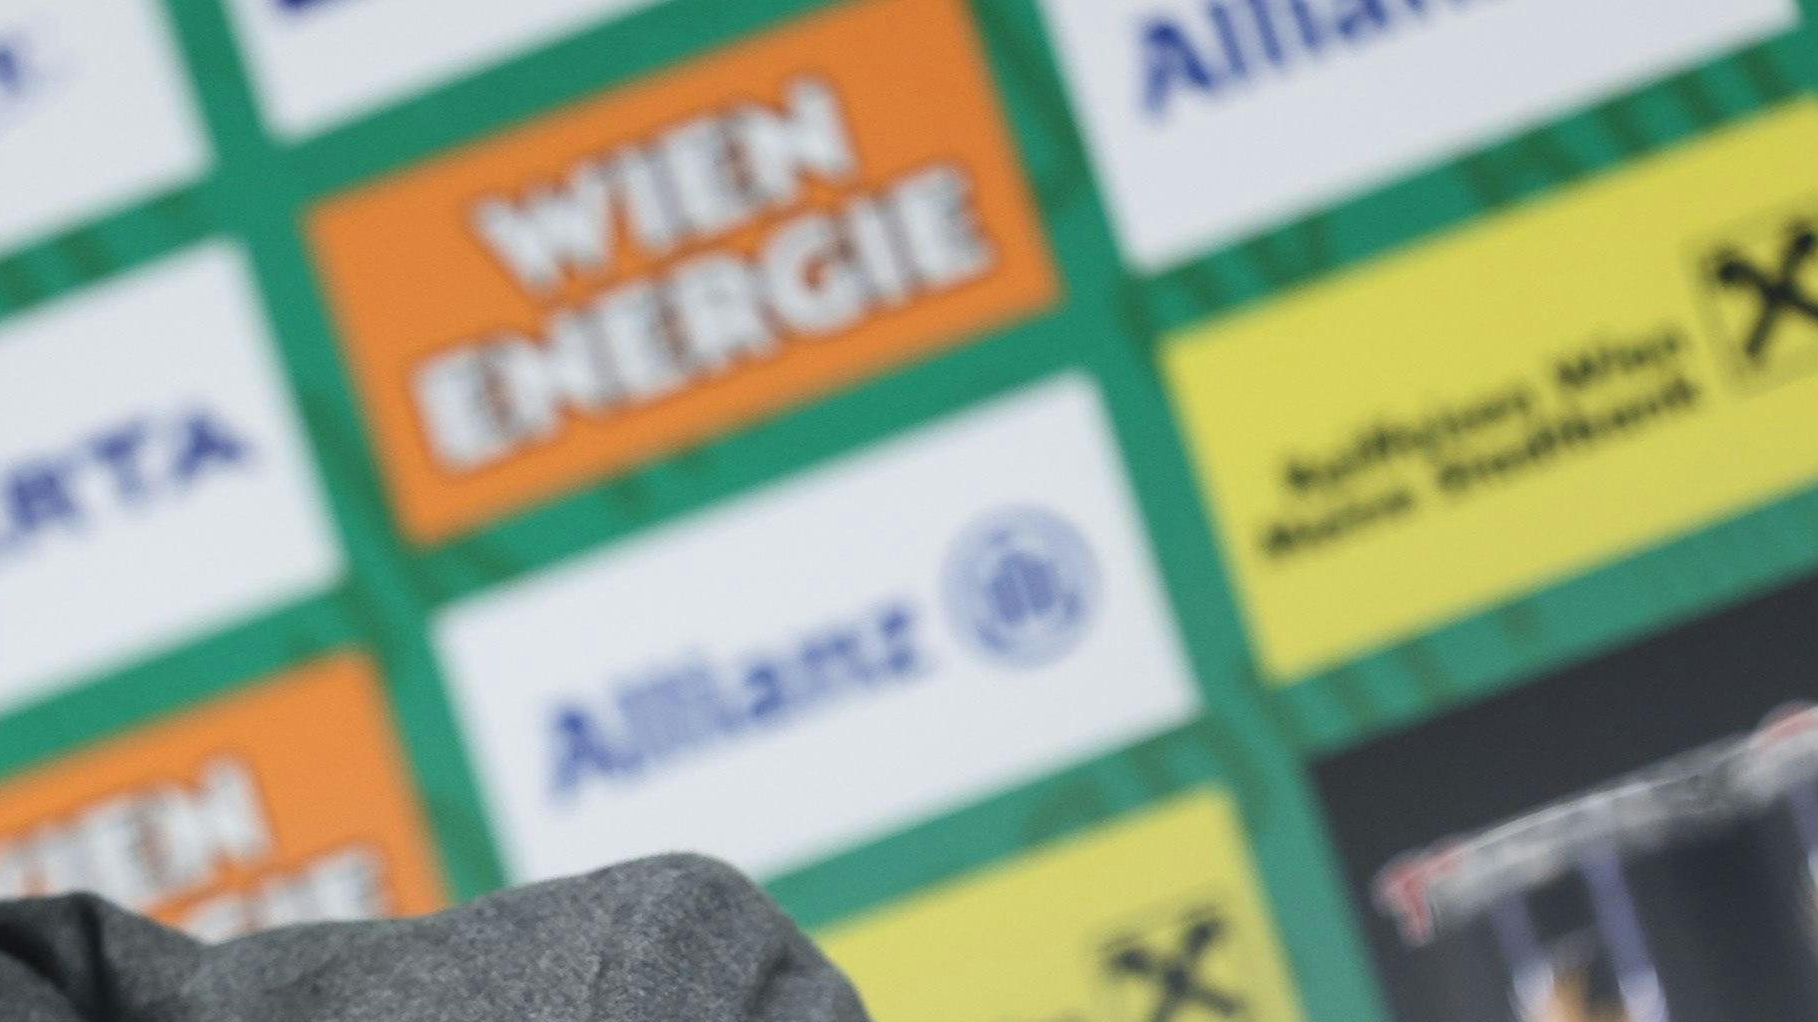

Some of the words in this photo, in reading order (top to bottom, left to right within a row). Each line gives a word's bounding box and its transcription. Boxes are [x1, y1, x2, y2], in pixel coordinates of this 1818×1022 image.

[472, 76, 856, 297] WIEN
[410, 158, 998, 476] ENERGIE
[545, 600, 927, 802] Allianz
